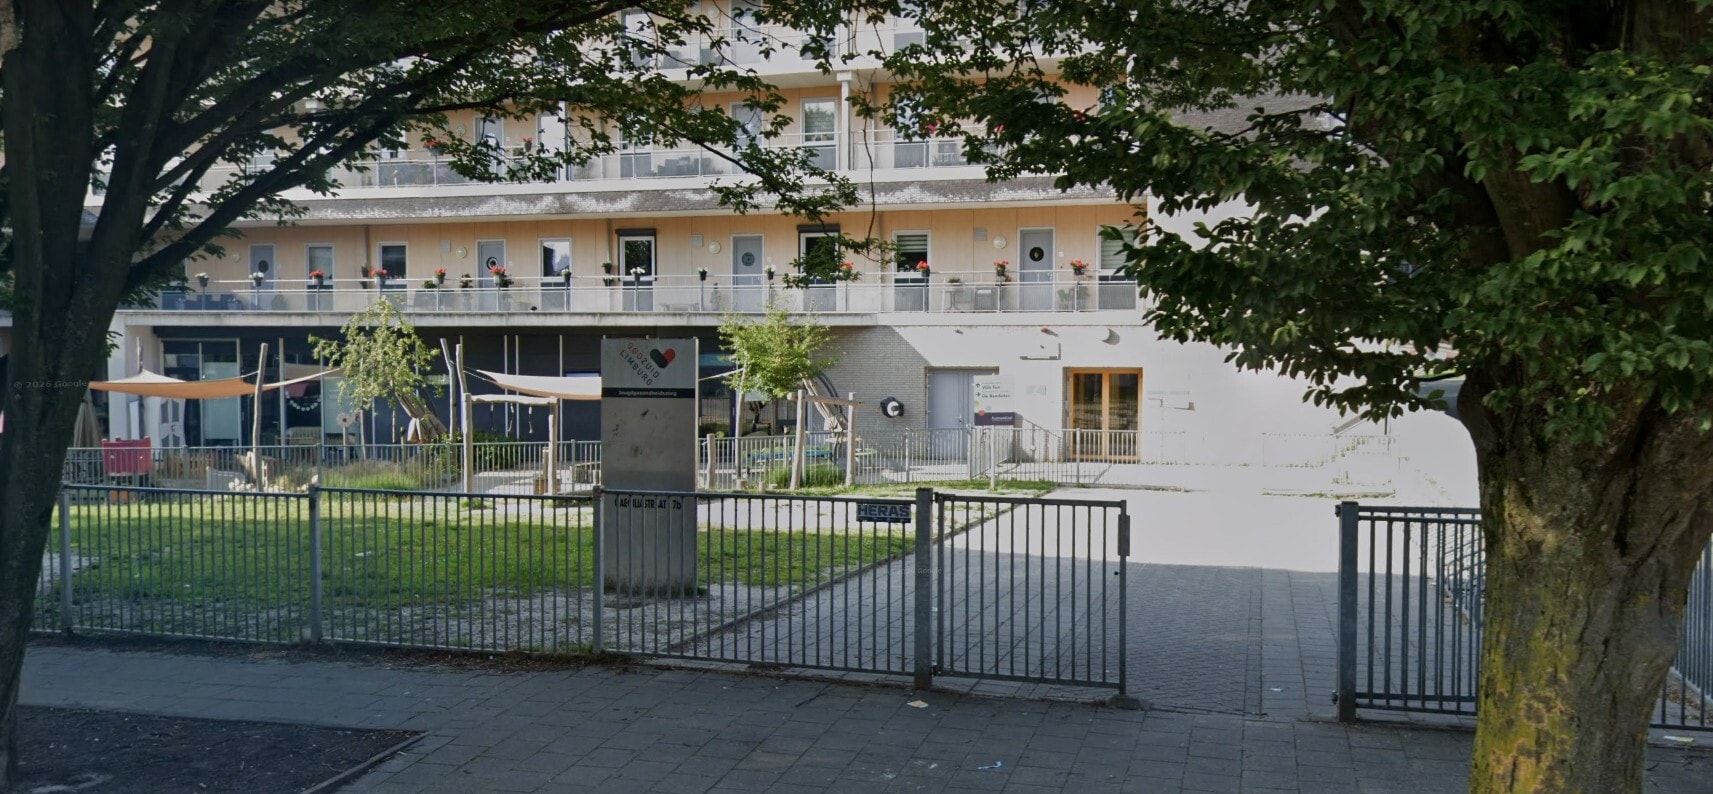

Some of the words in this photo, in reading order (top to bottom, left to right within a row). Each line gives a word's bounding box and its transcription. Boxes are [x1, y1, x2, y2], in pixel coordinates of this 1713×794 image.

[620, 349, 654, 386] LIMBURG
[672, 500, 682, 510] 7b
[857, 504, 910, 516] HERAS
